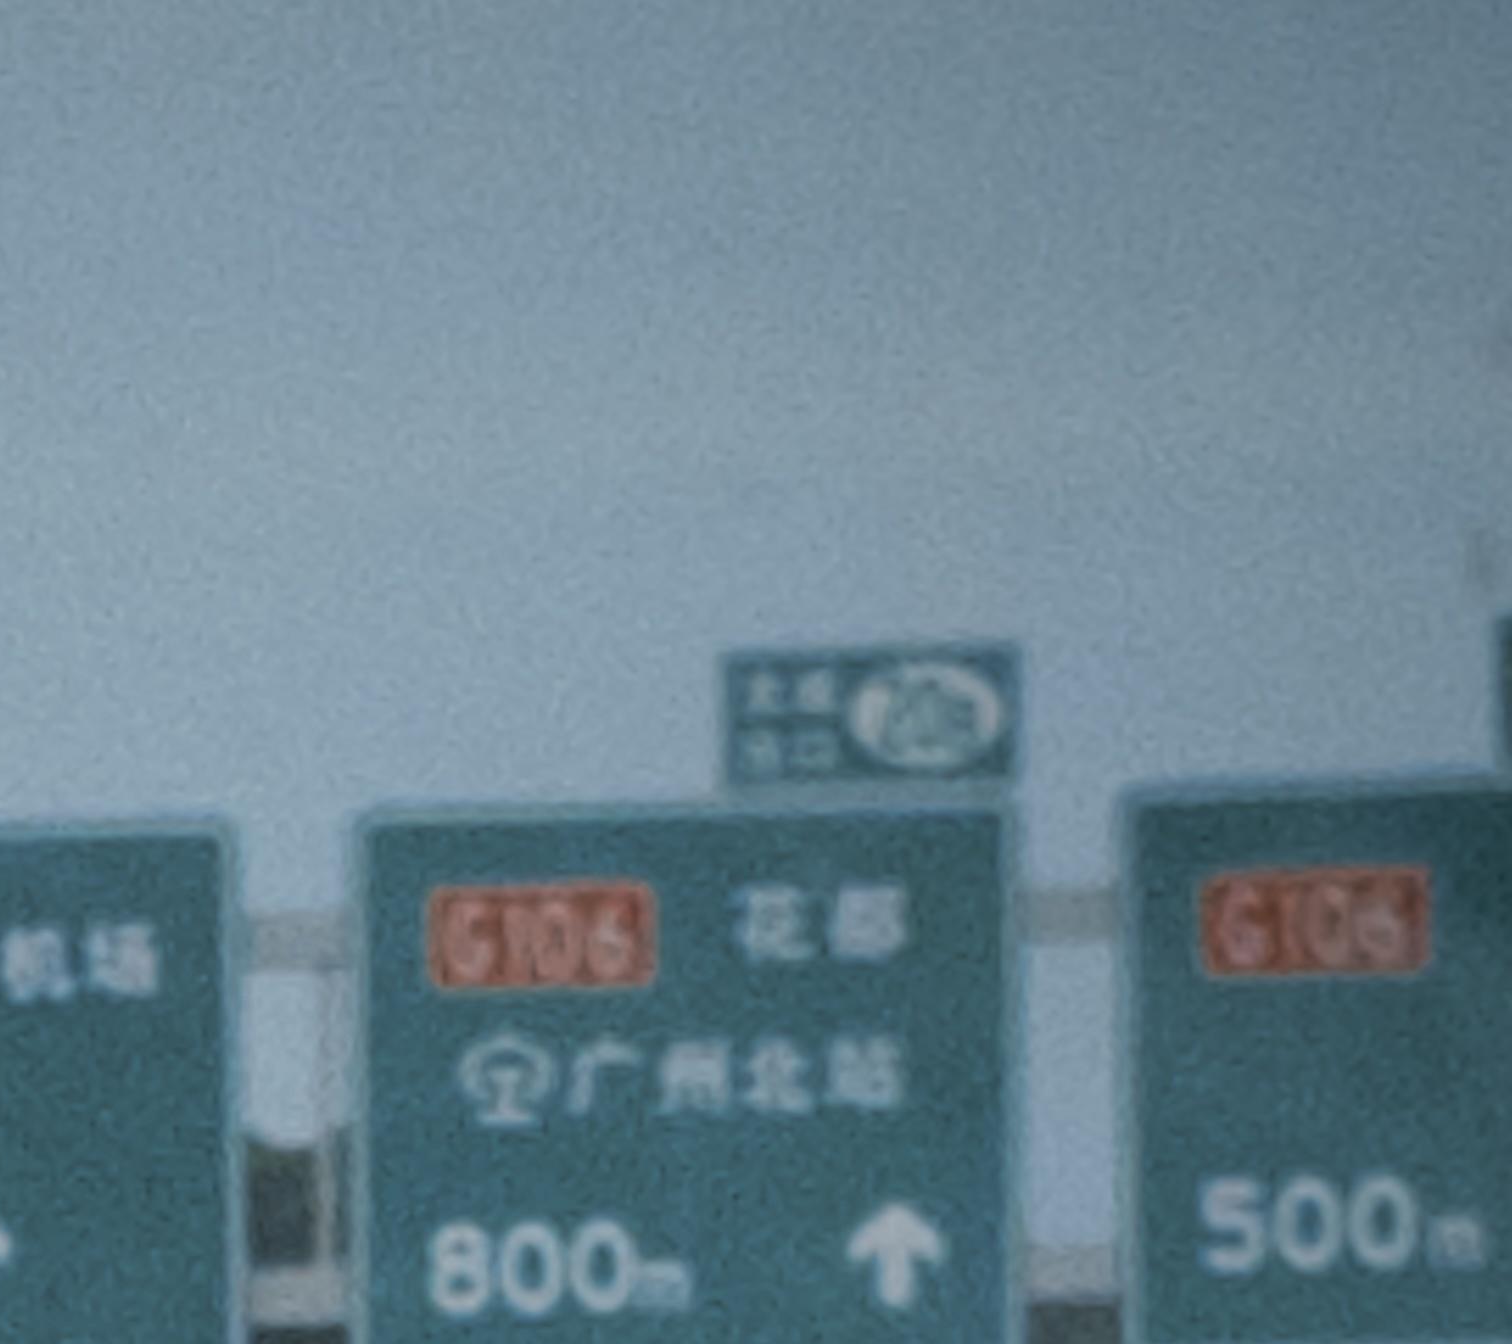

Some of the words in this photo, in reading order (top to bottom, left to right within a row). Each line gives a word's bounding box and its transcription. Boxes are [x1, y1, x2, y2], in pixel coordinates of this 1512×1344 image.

[567, 1036, 904, 1114] 广州北站
[430, 1218, 692, 1319] 800m
